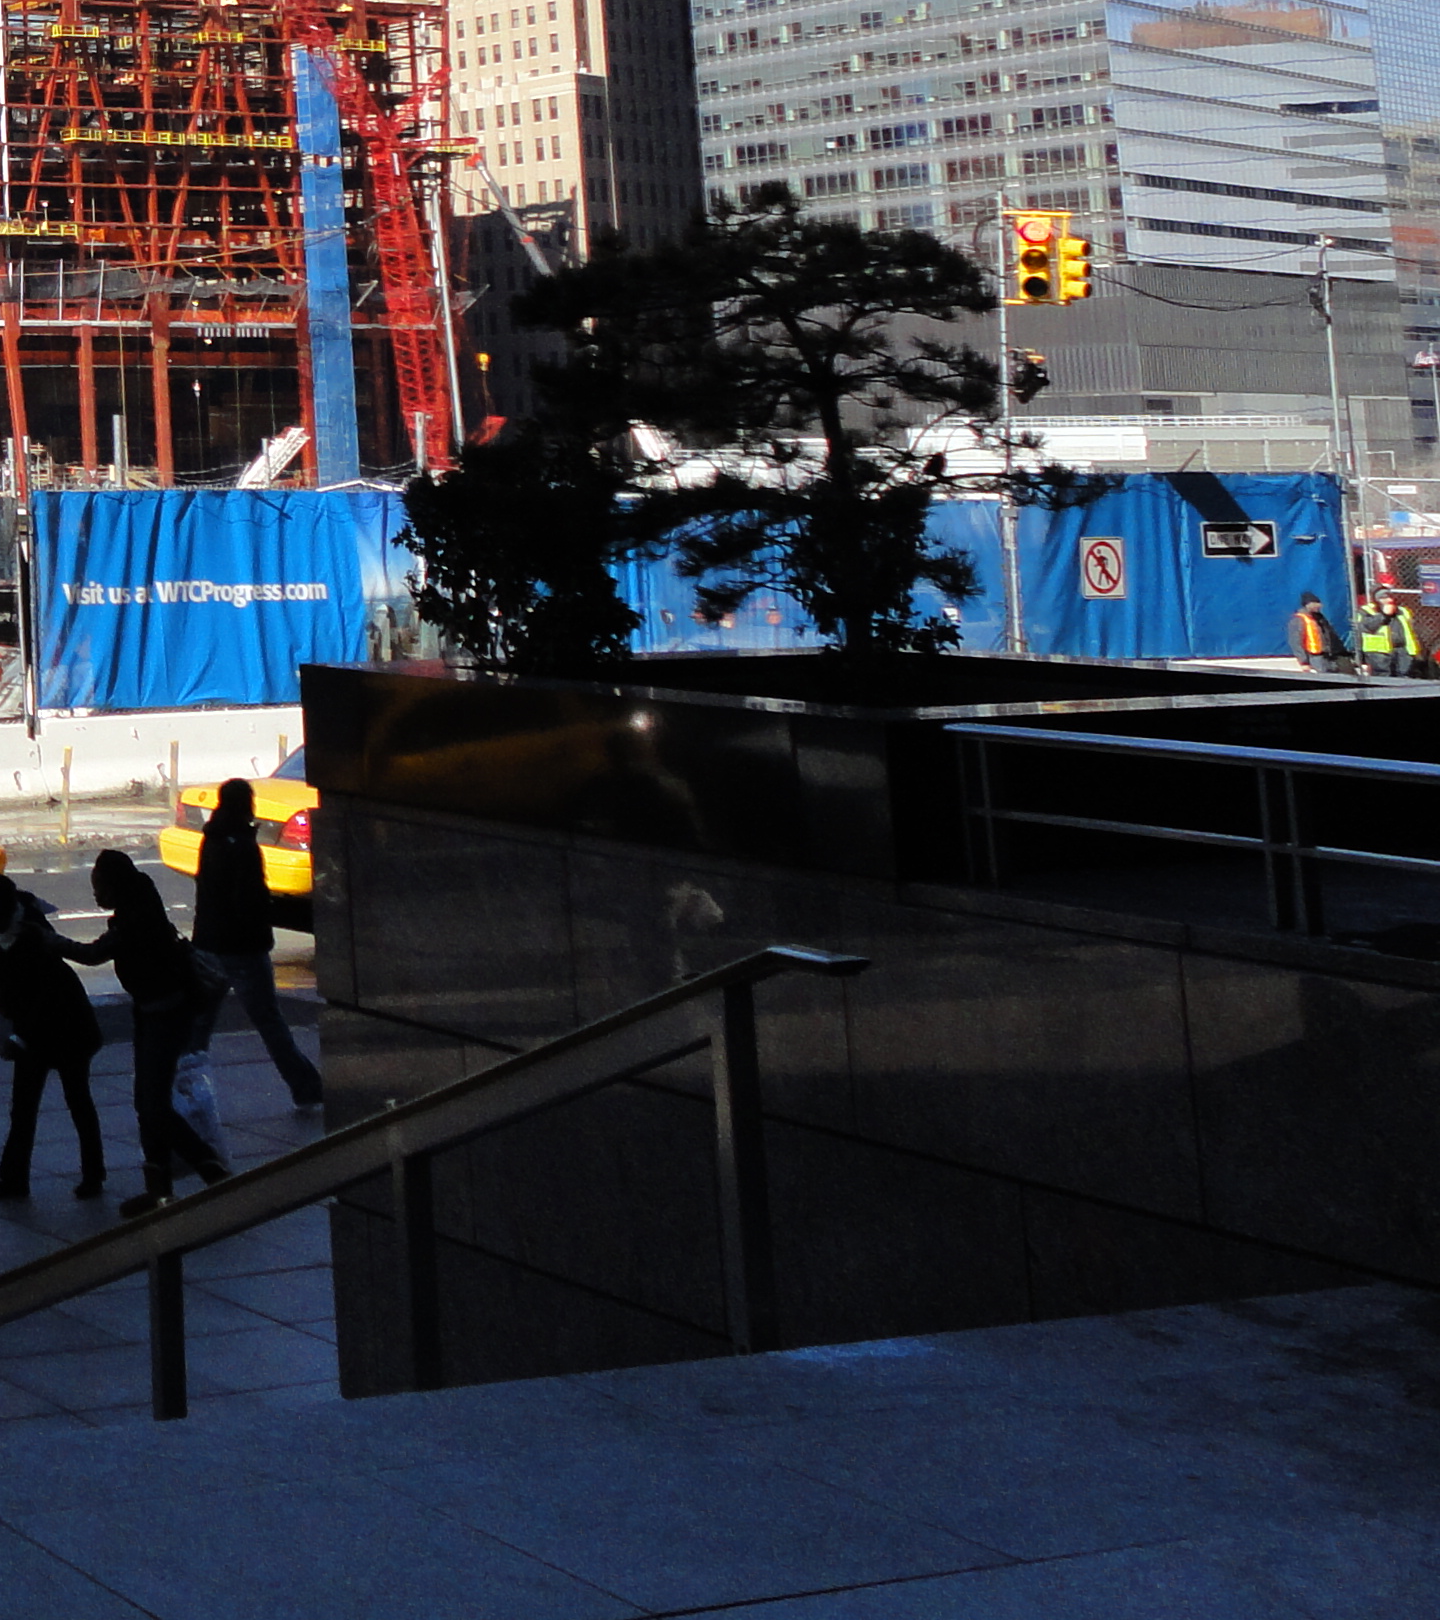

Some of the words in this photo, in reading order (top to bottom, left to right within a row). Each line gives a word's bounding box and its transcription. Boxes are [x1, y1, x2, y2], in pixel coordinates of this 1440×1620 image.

[62, 580, 104, 605] Visit
[109, 587, 131, 604] us
[155, 581, 327, 608] WTCProgress.com
